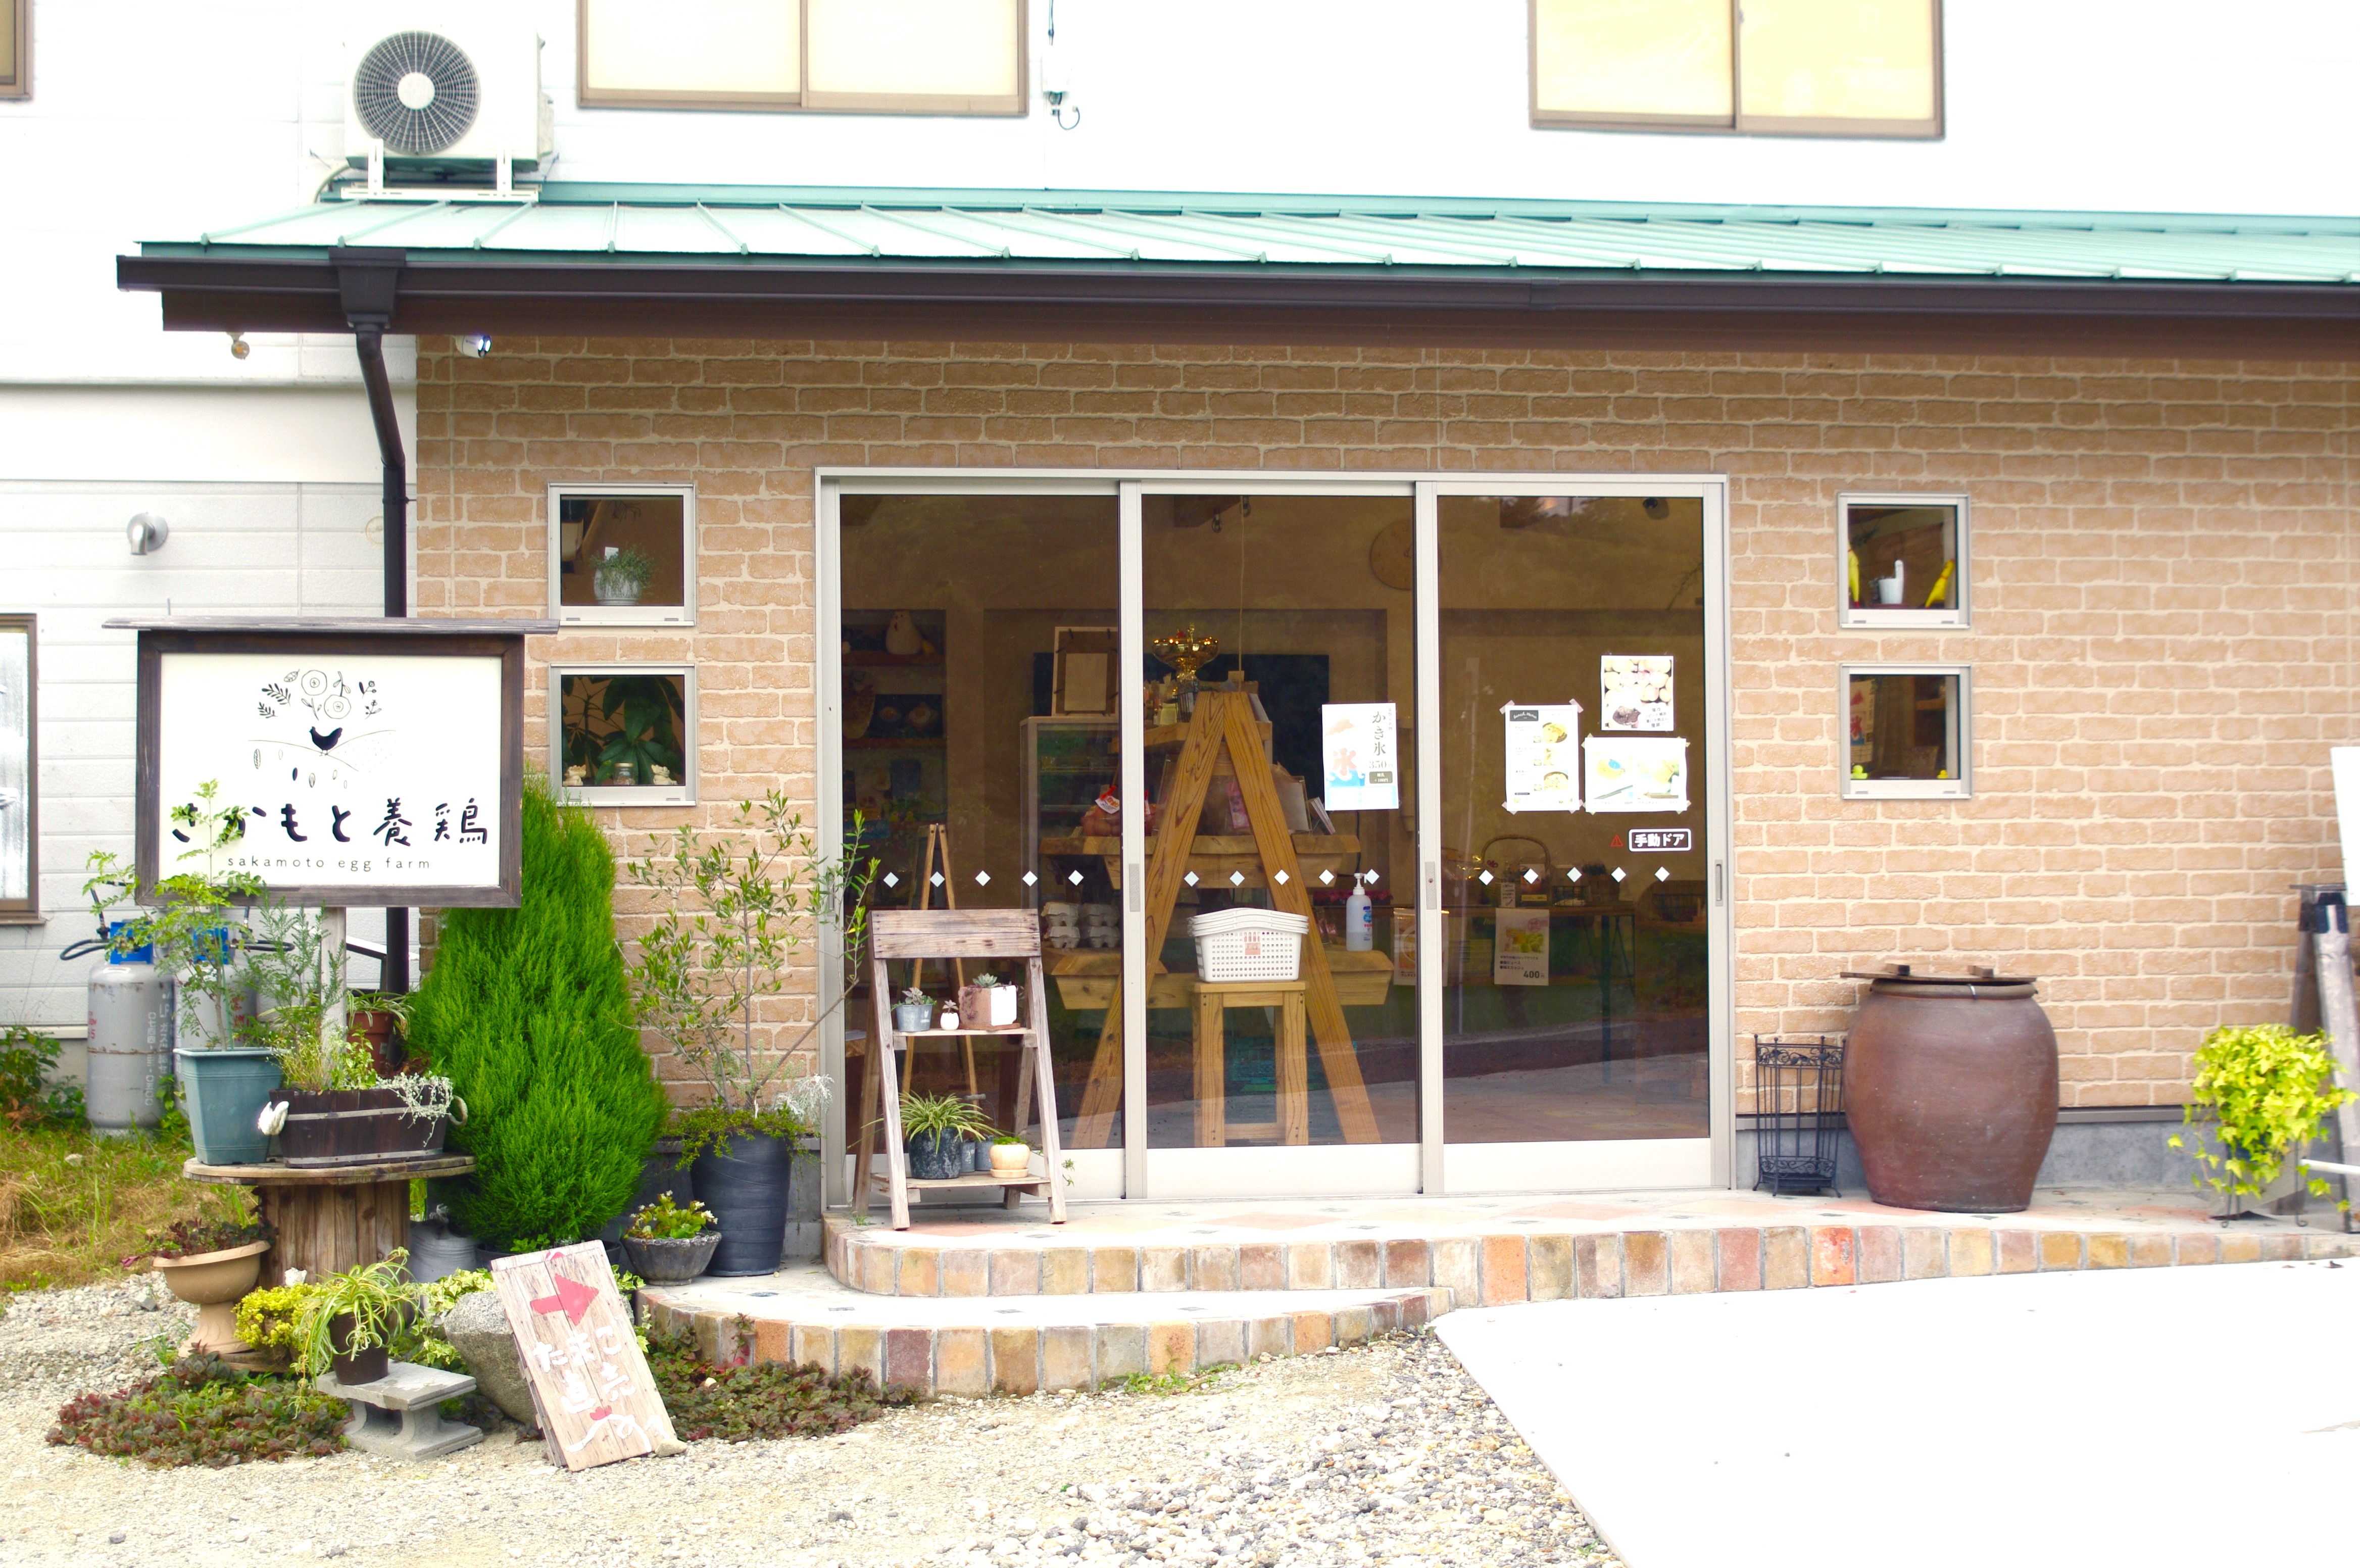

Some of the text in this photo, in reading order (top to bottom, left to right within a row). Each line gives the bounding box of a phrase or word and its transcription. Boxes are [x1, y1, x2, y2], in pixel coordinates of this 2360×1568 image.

[1372, 711, 1386, 756] かき氷
[1333, 748, 1357, 776] 氷
[1634, 833, 1685, 847] 手動ドア
[228, 855, 429, 872] sakamoto egg farm
[532, 1317, 622, 1373] たまご
[561, 1362, 636, 1414] 直売
